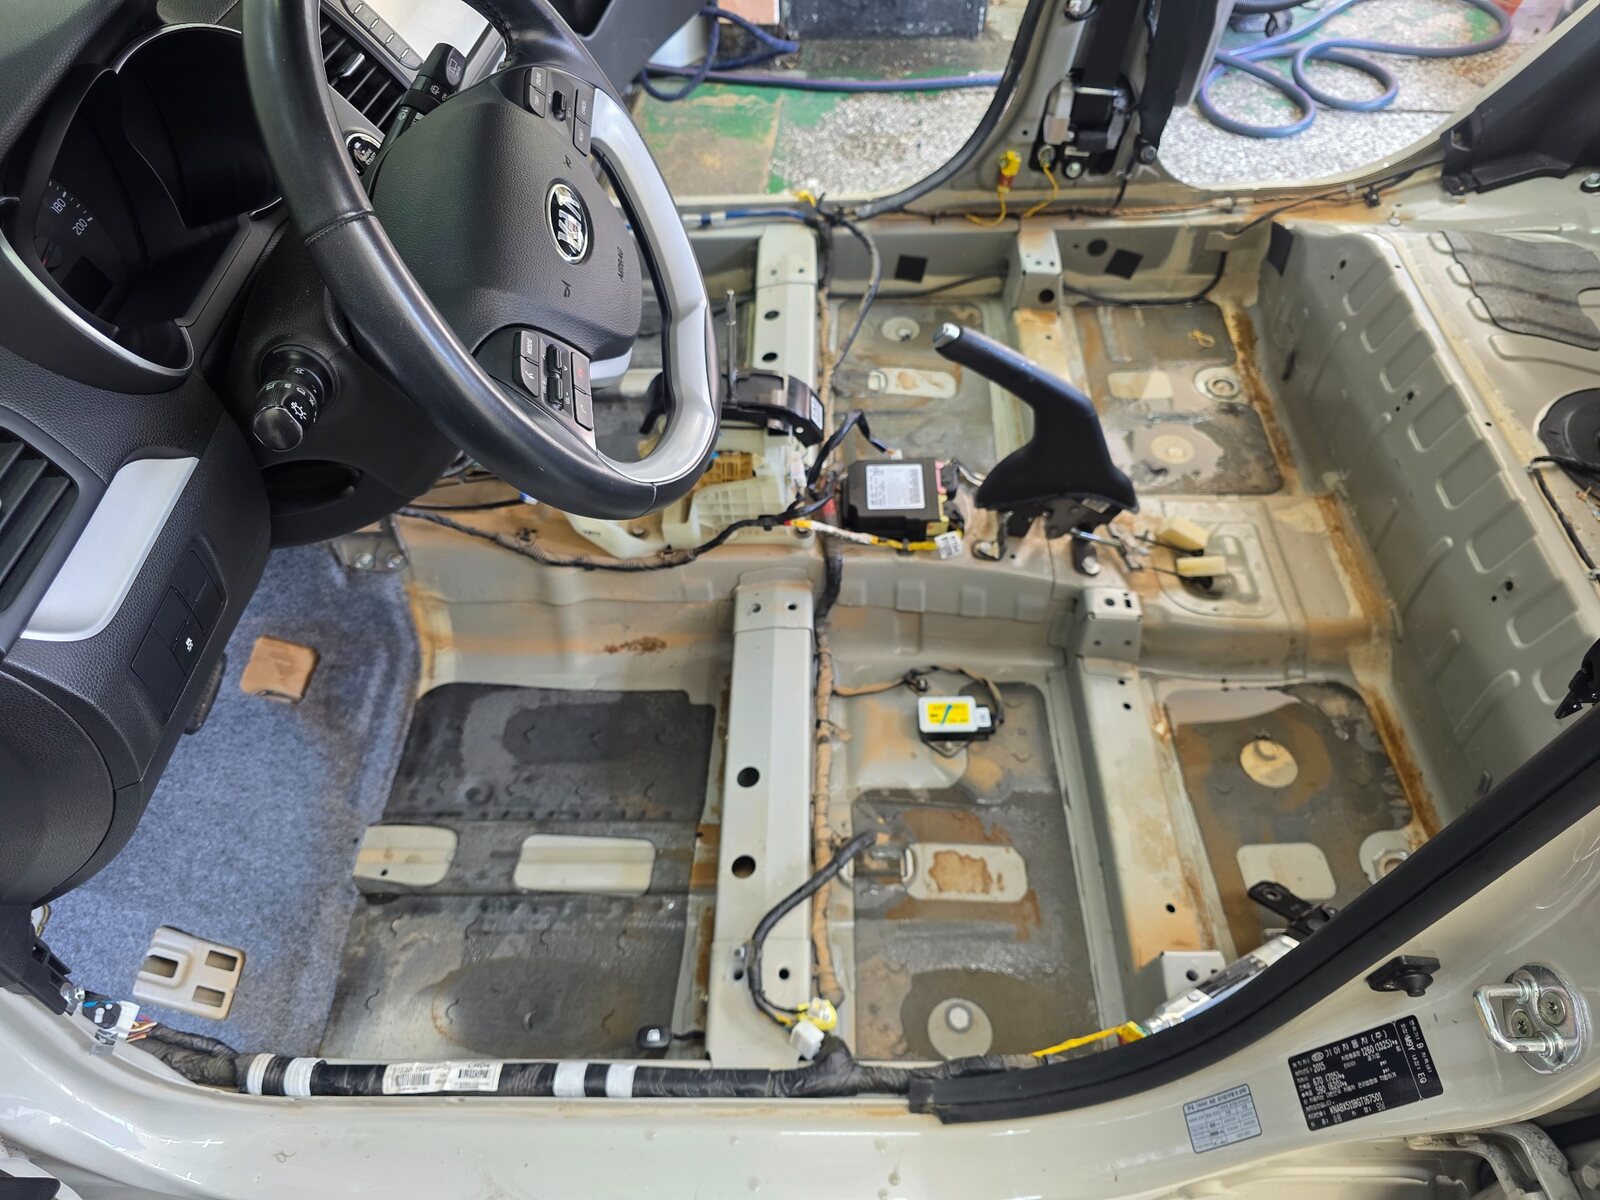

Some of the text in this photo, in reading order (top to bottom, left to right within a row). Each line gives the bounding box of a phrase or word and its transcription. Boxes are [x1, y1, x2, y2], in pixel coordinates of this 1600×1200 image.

[50, 198, 66, 214] 180
[72, 218, 88, 236] 200
[553, 186, 585, 257] KIA
[1361, 1045, 1375, 1056] 1260
[1313, 1061, 1326, 1073] 2015
[1313, 1076, 1323, 1087] 670
[1316, 1085, 1326, 1095] 590
